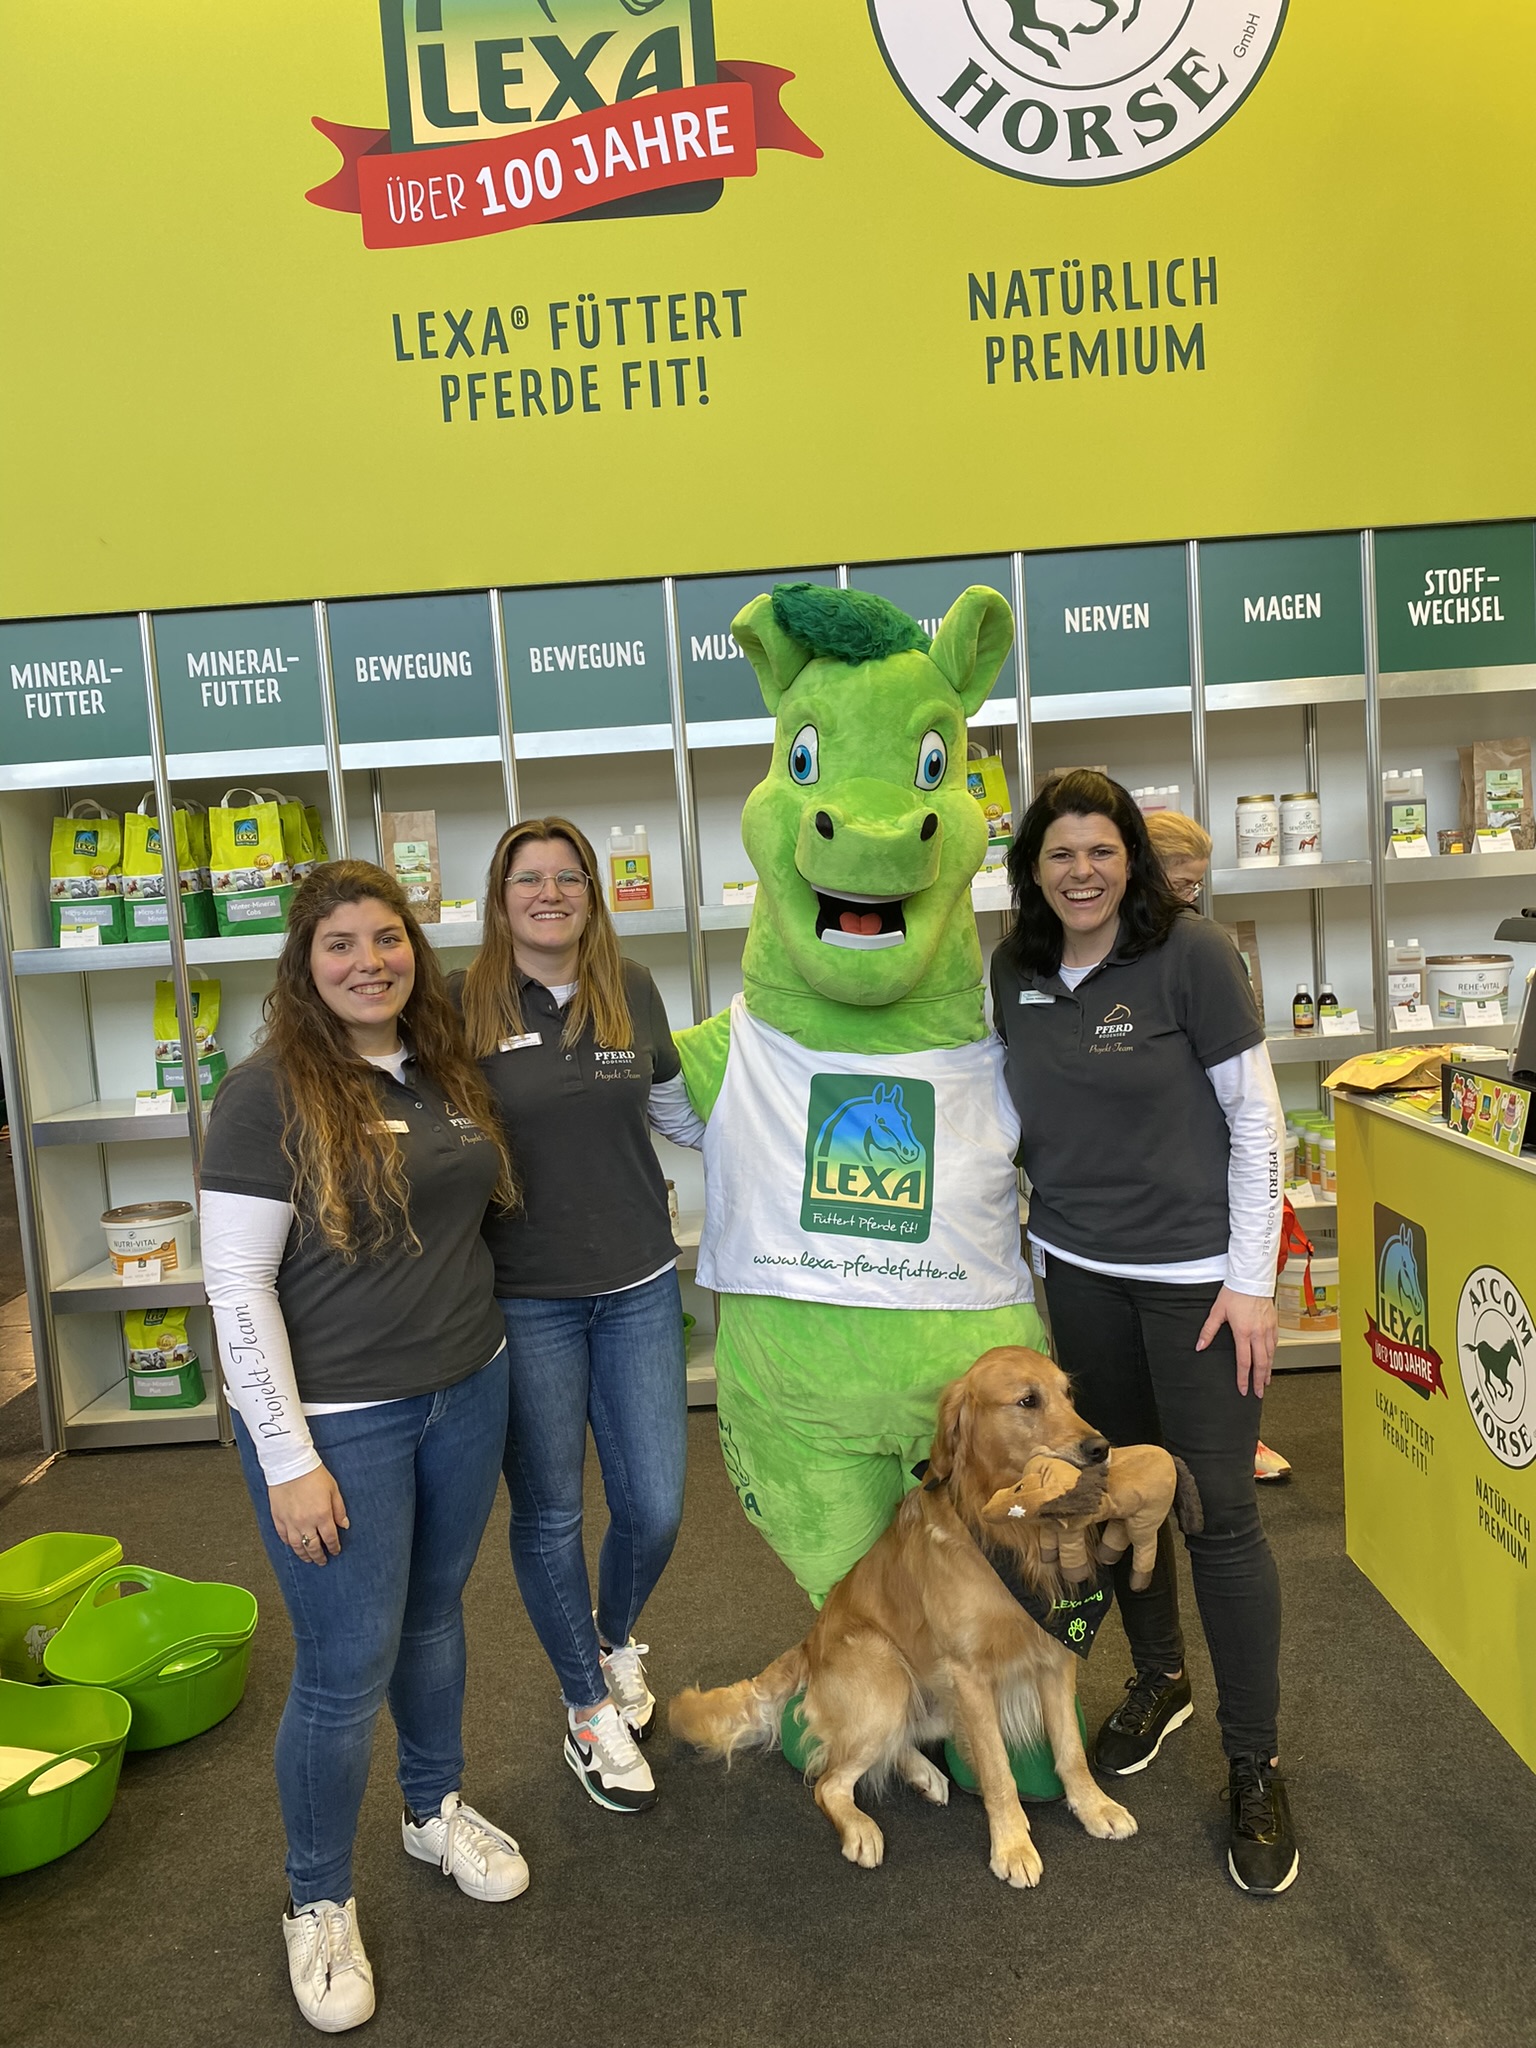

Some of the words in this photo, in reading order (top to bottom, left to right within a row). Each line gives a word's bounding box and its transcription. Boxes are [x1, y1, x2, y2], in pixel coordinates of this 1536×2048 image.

[1233, 13, 1260, 58] GmbH
[417, 26, 681, 128] LEXA
[937, 47, 1229, 161] HORSE
[386, 174, 466, 224] ÜBER
[476, 148, 563, 215] 100
[574, 106, 734, 184] JAHRE
[968, 256, 1217, 320] NATÜRLICH
[549, 289, 747, 350] FÜTTERT
[986, 323, 1205, 384] PREMIUM
[441, 365, 600, 422] PFERDE
[622, 356, 709, 410] FIT!
[1424, 566, 1500, 596] STOFF-
[1064, 603, 1150, 633] NERVEN
[1244, 592, 1321, 623] MAGEN
[1407, 596, 1504, 627] WECHSEL
[187, 647, 300, 678] MINERAL-
[355, 651, 472, 683] BEWEGUNG
[529, 641, 646, 673] BEWEGUNG
[10, 658, 123, 690] MINERAL-
[25, 688, 106, 719] FUTTER
[201, 678, 281, 708] FUTTER
[76, 843, 96, 853] LEXA
[148, 842, 161, 851] LEX
[236, 832, 257, 841] LEXA
[246, 907, 262, 916] Cobs
[1095, 1023, 1133, 1034] PFERD
[594, 1051, 635, 1061] PFERD
[816, 1160, 921, 1203] LEXA
[1269, 1151, 1278, 1199] PFERD
[813, 1212, 855, 1226] Füttert
[859, 1216, 897, 1232] Pferde
[900, 1220, 918, 1234] fit!
[114, 1238, 157, 1248] NUTRI-VITAL
[753, 1251, 967, 1280] www.lexa-pferdefutter.de
[1380, 1297, 1423, 1349] LEXA
[1468, 1277, 1533, 1348] ATCOM
[1375, 1340, 1388, 1364] ÜBER
[1389, 1348, 1403, 1372] 100
[1404, 1352, 1433, 1383] JAHRE
[1400, 1409, 1434, 1455] FÜTTERT
[1471, 1388, 1533, 1457] HORSE
[1383, 1419, 1408, 1458] PFERDE
[1412, 1445, 1428, 1475] FIT!
[1475, 1475, 1531, 1543] NATÜRLICH
[1479, 1505, 1528, 1569] PREMIUM
